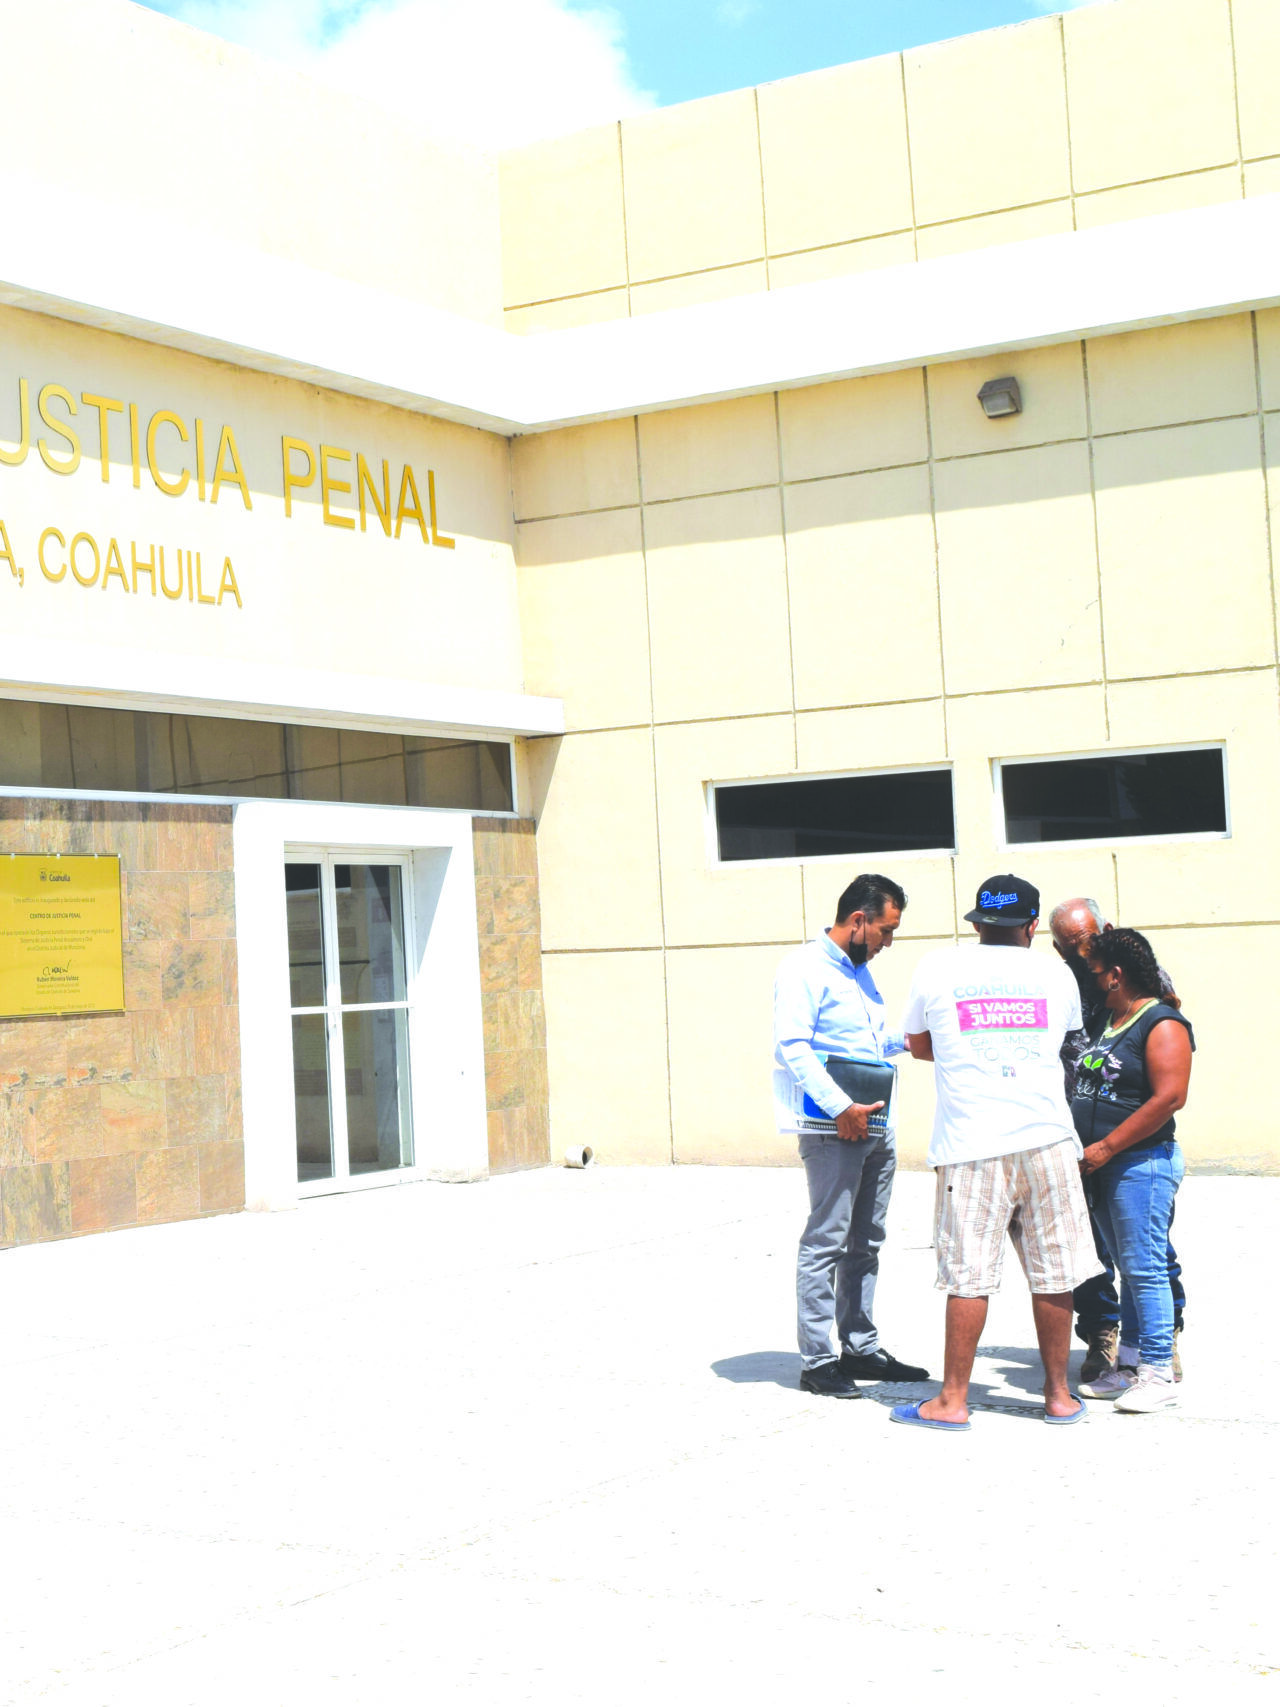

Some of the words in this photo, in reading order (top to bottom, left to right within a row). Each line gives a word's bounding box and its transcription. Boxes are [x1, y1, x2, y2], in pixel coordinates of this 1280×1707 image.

[282, 435, 456, 549] PENAL
[38, 527, 243, 608] COAHUILA
[980, 891, 1018, 908] Dodgers
[953, 984, 1045, 998] COAHUILA
[969, 1003, 981, 1013] SI
[983, 1001, 1035, 1012] VAMOS
[971, 1012, 1036, 1026] JUNTOS
[970, 1035, 1040, 1047] GAAMOS
